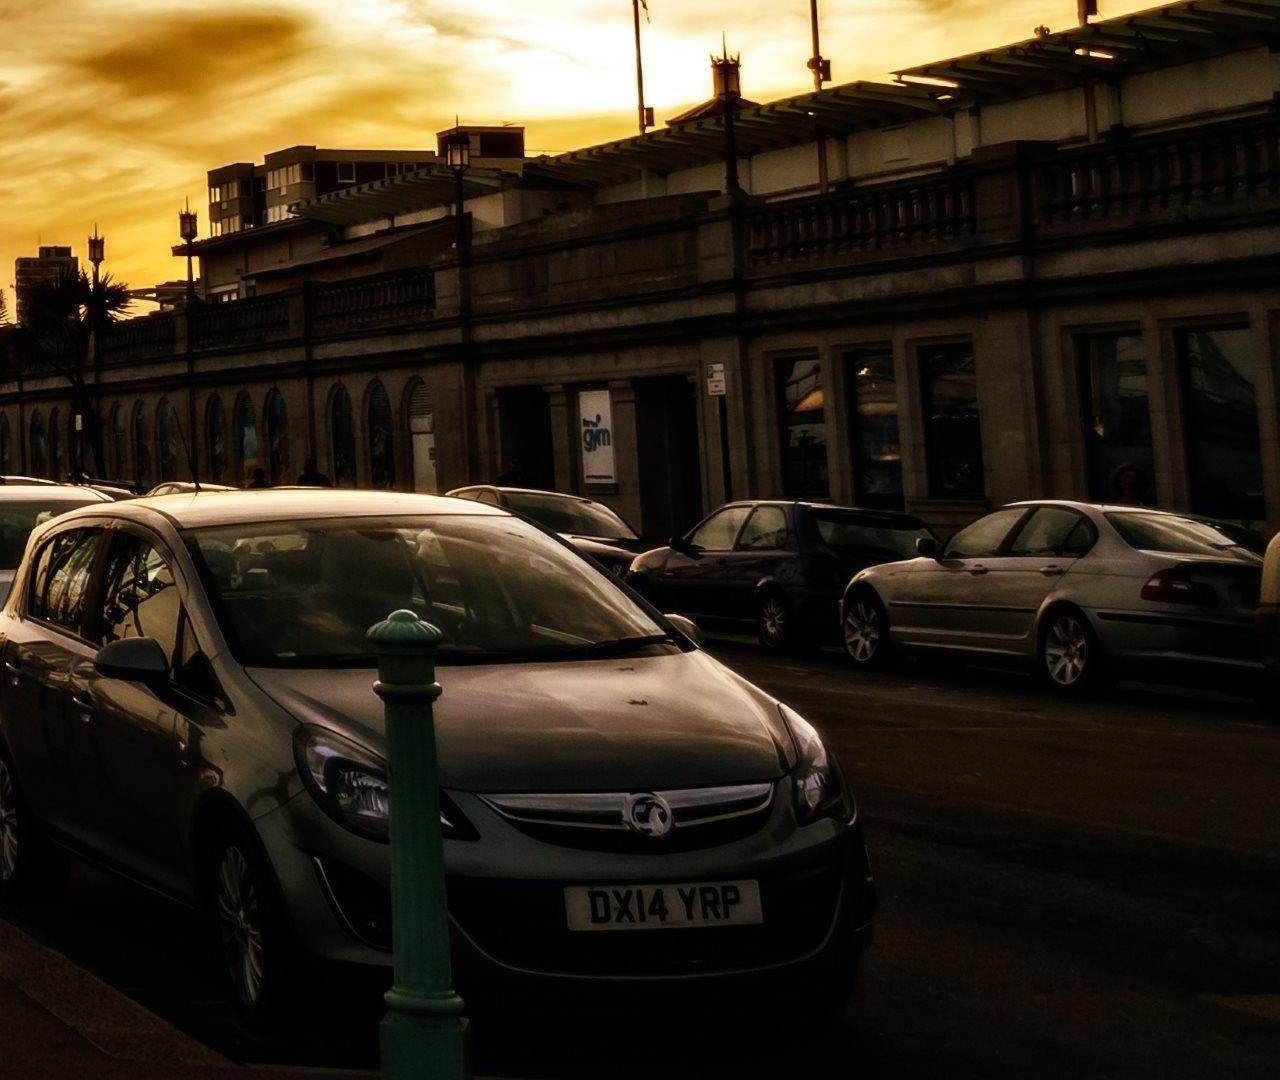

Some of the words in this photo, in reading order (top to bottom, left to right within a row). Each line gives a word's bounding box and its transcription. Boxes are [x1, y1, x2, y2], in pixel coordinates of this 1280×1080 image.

[583, 428, 611, 452] gym
[587, 888, 670, 924] DX14
[677, 885, 741, 921] YRP
